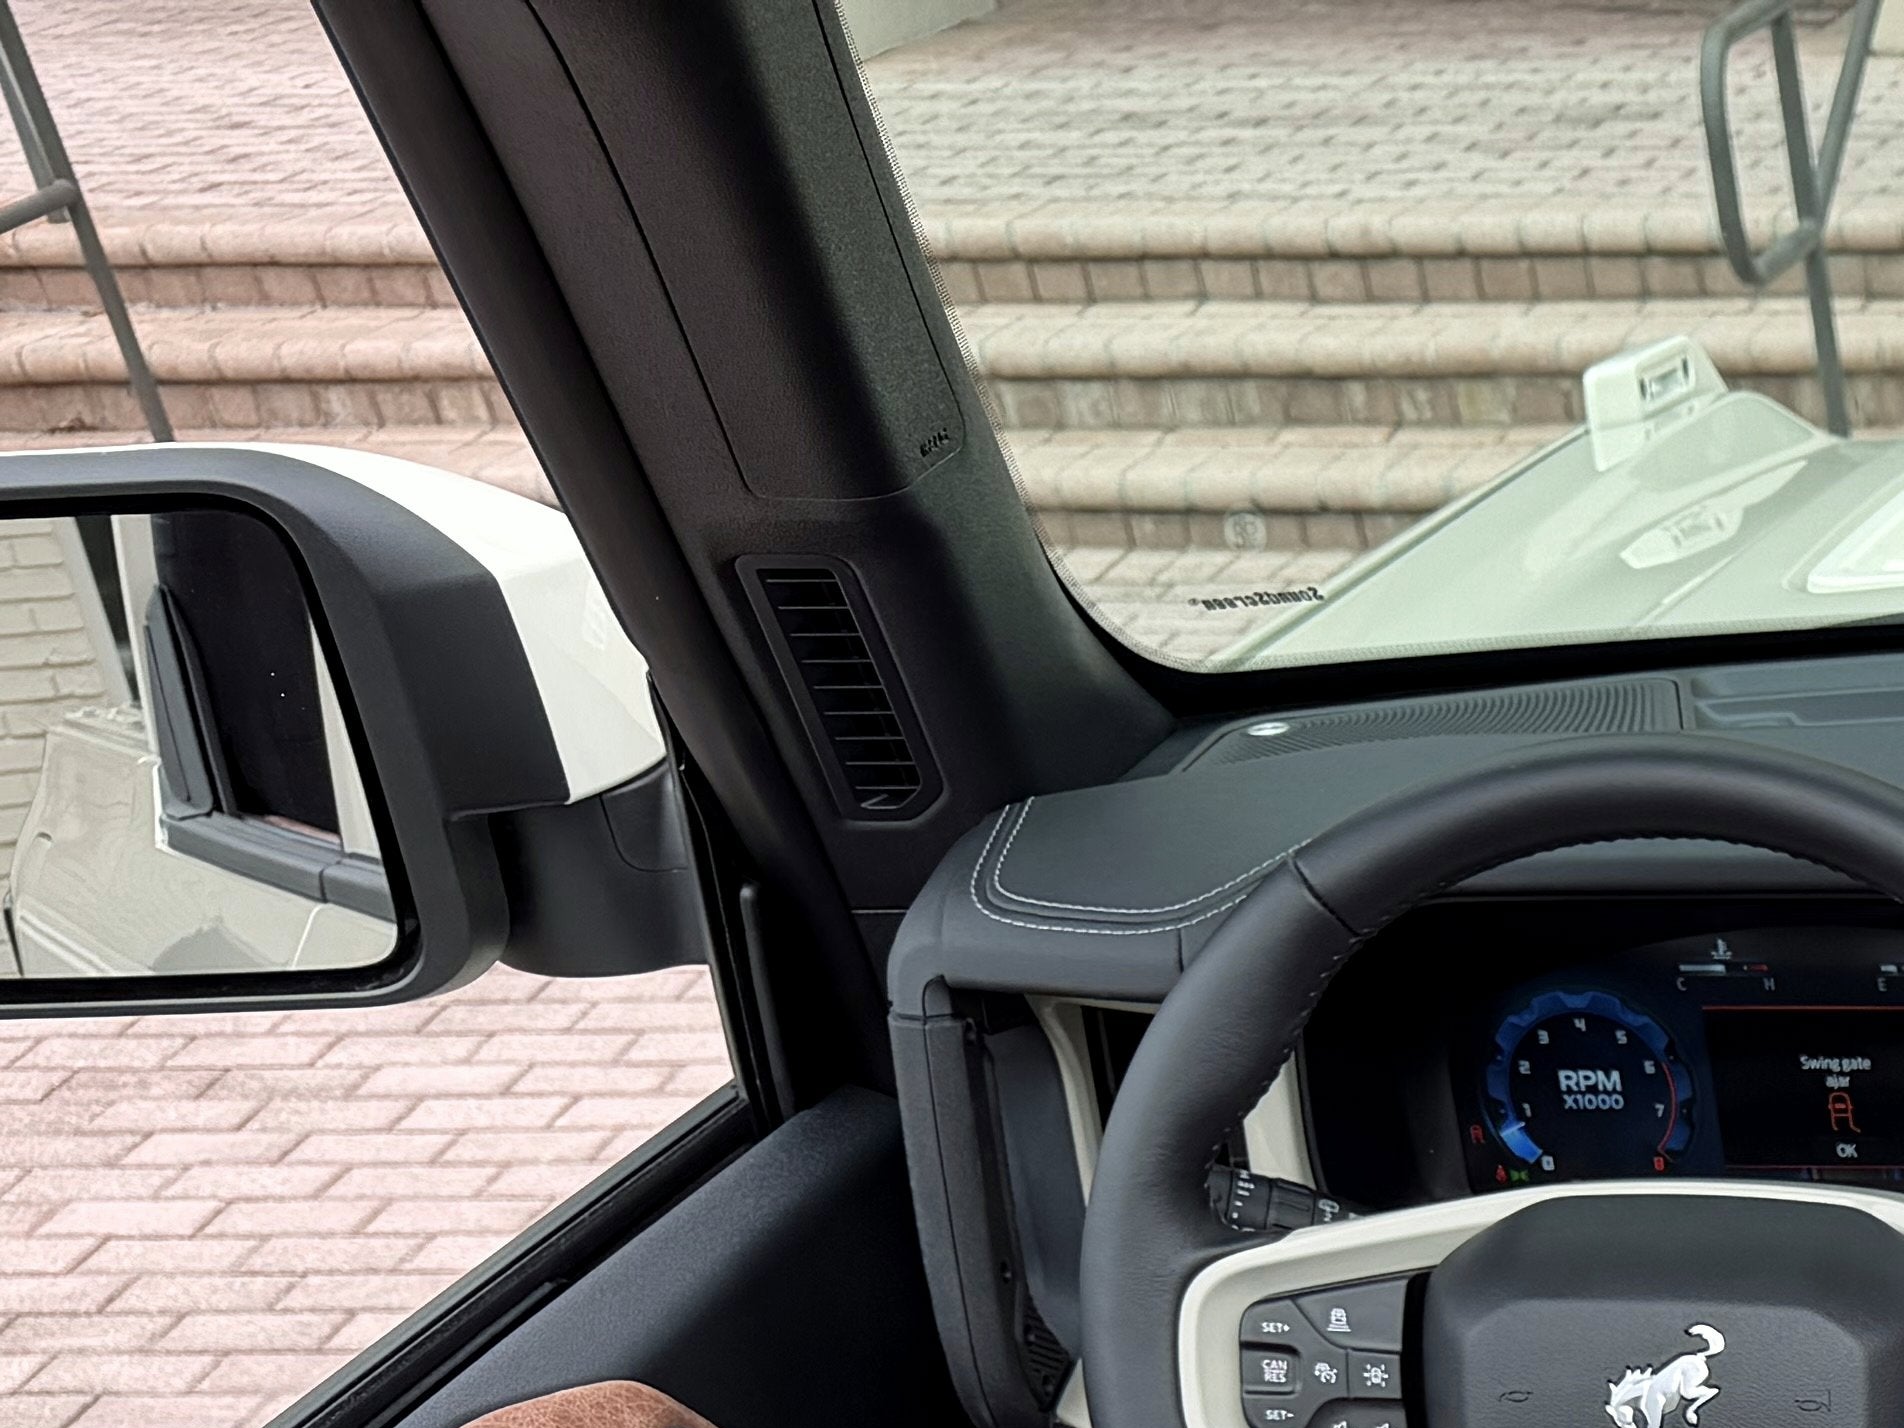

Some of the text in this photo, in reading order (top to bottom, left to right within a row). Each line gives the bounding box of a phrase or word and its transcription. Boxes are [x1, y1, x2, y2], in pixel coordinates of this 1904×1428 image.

[1573, 1017, 1586, 1032] 4
[1536, 1029, 1550, 1045] 3
[1615, 1029, 1628, 1045] 5
[1800, 1055, 1872, 1073] Swing gate
[1557, 1069, 1623, 1092] RPM
[1562, 1094, 1624, 1110] X1000
[1836, 1143, 1858, 1158] OK
[1262, 1359, 1288, 1371] CAN
[1264, 1371, 1287, 1383] RES
